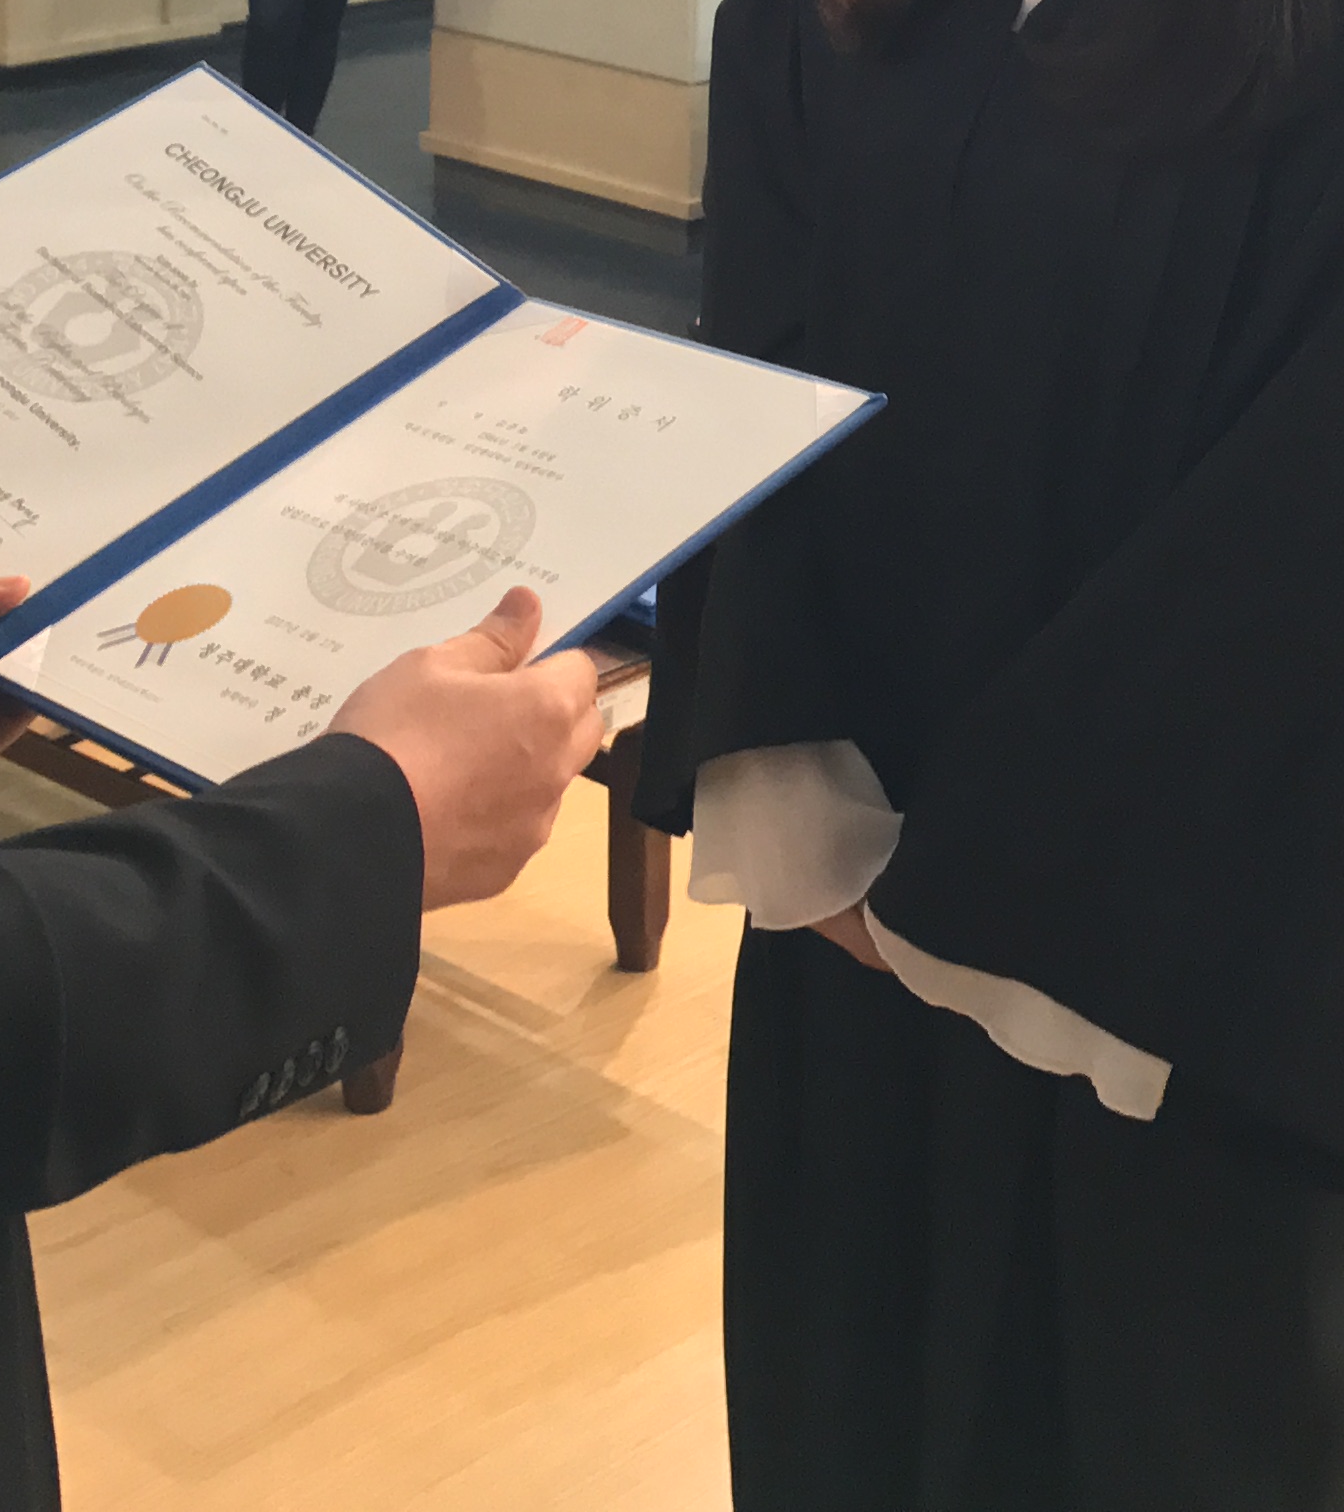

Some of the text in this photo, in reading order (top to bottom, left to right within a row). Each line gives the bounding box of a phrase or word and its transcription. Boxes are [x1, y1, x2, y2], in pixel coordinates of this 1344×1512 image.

[164, 143, 268, 218] CHEONGJU
[263, 214, 380, 299] UNIVERSITY
[198, 642, 288, 690] 청주대학교
[290, 684, 333, 710] 총장
